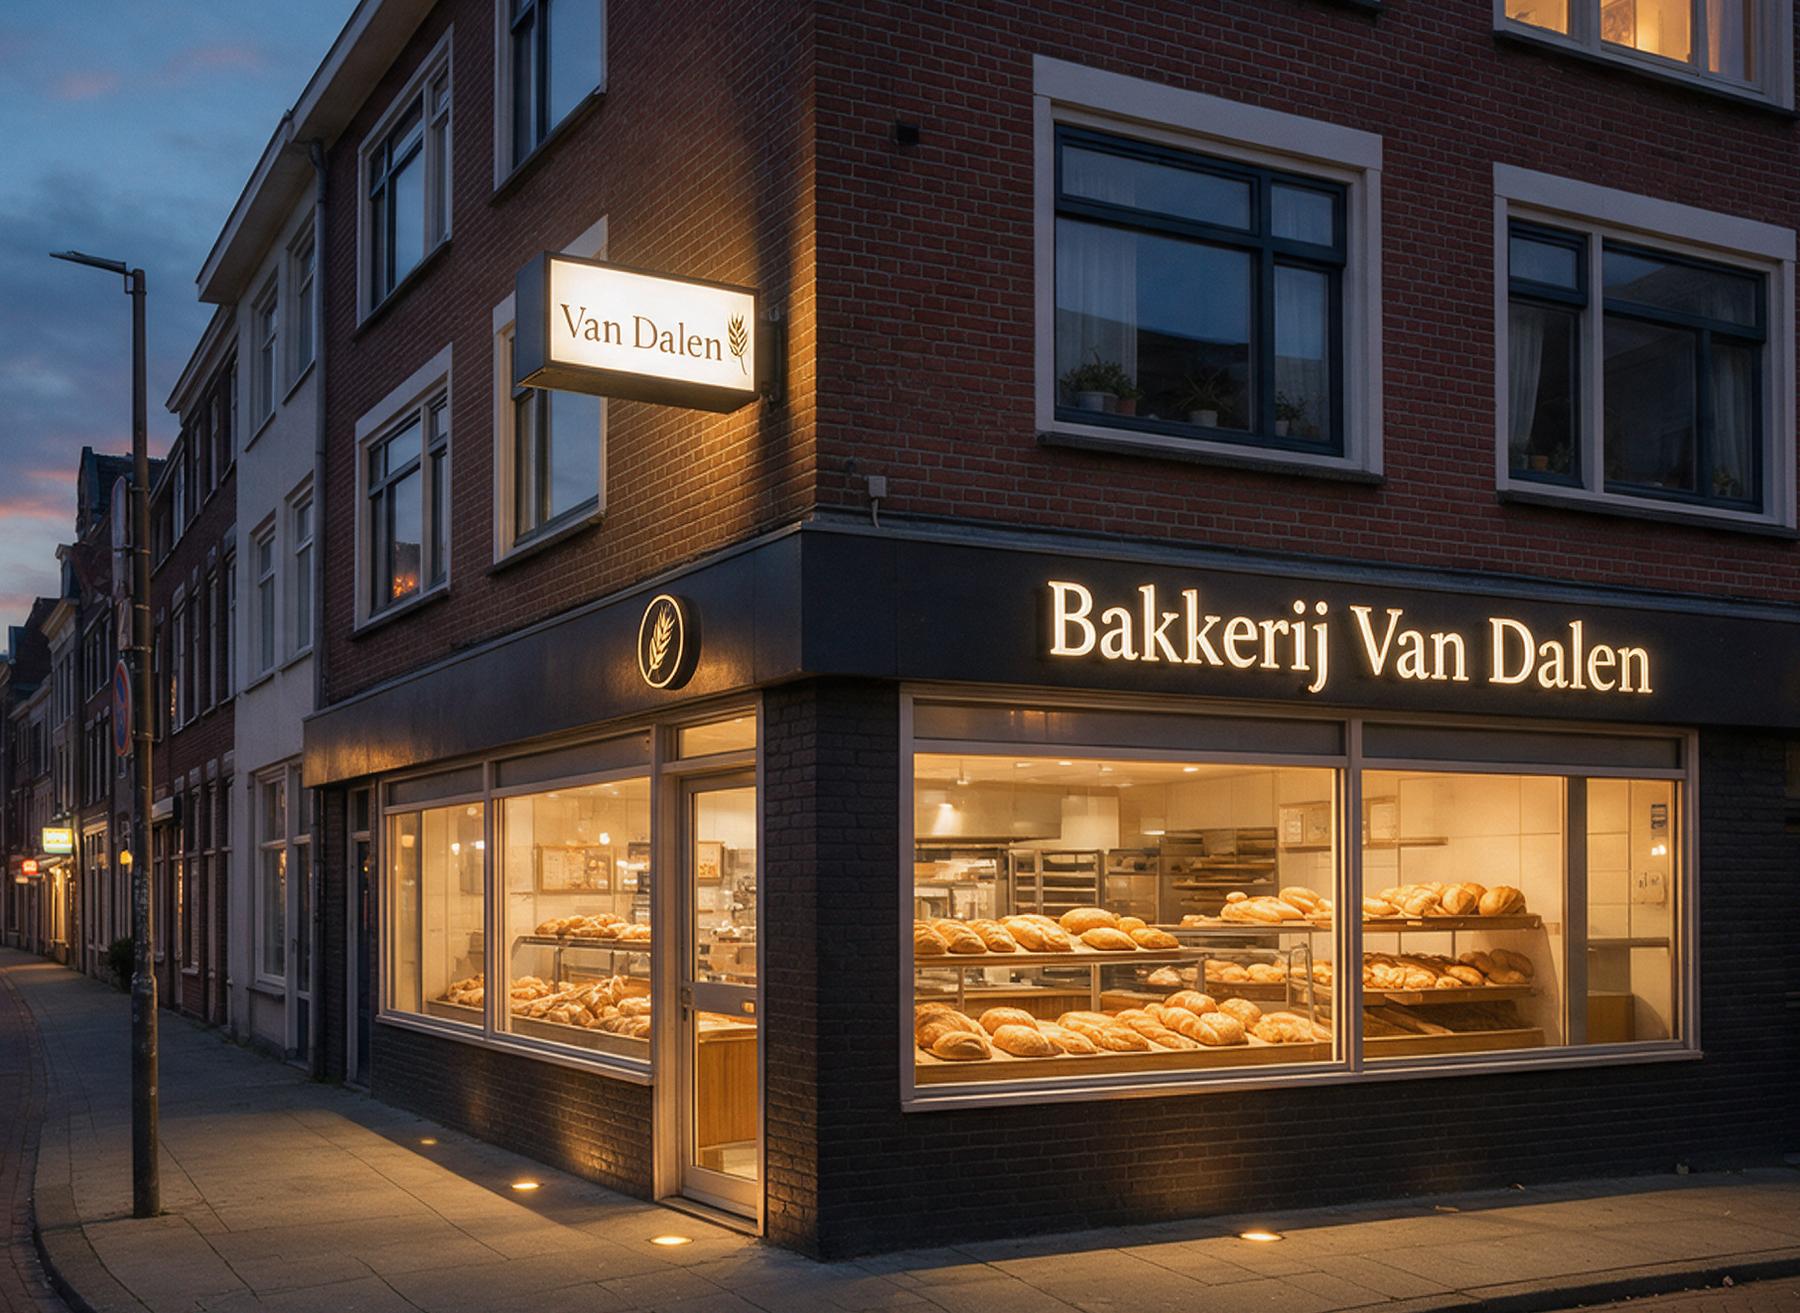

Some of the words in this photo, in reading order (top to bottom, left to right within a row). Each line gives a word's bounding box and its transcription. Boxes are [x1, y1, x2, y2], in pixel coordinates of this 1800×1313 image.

[560, 303, 622, 346] Van
[632, 315, 722, 361] Dalen
[1048, 581, 1328, 692] Bakkerij
[1350, 605, 1469, 682] Van
[1488, 617, 1653, 693] Dalen
